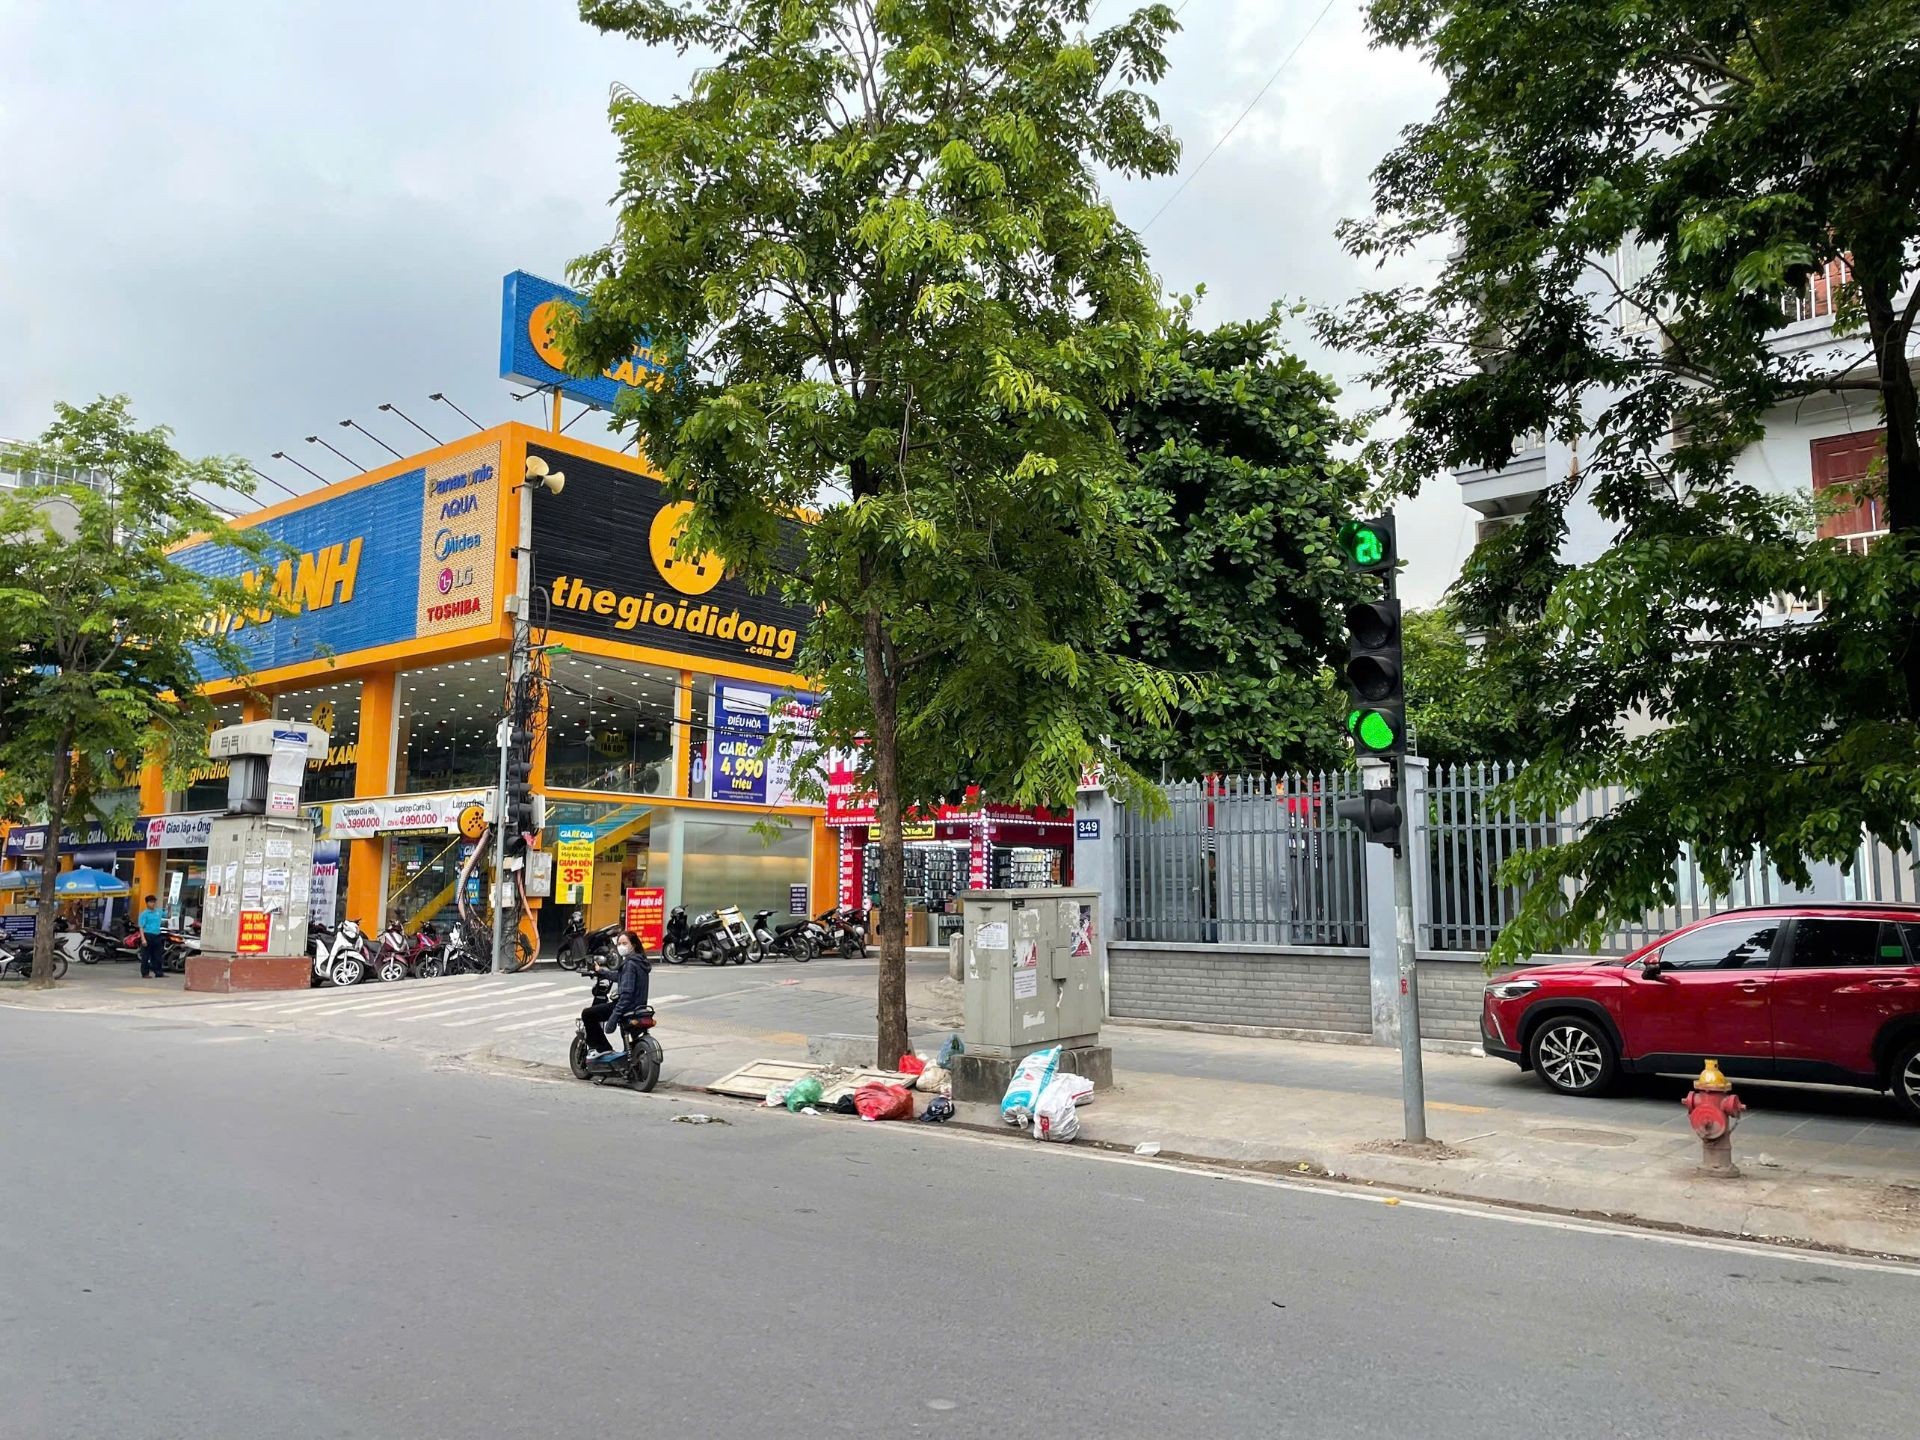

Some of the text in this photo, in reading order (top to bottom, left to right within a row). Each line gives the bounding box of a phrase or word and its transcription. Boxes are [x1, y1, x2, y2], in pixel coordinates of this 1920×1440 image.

[429, 464, 493, 498] Panasonic
[440, 494, 478, 521] AQUA
[438, 529, 481, 559] Midea
[233, 537, 364, 630] XANH
[454, 566, 473, 589] LG
[427, 597, 481, 623] TOSHIBA
[551, 575, 797, 659] thegioididong
[325, 744, 357, 767] XAN
[720, 756, 763, 779] 4.990
[400, 813, 437, 825] 4.990.000
[1079, 821, 1098, 832] 349
